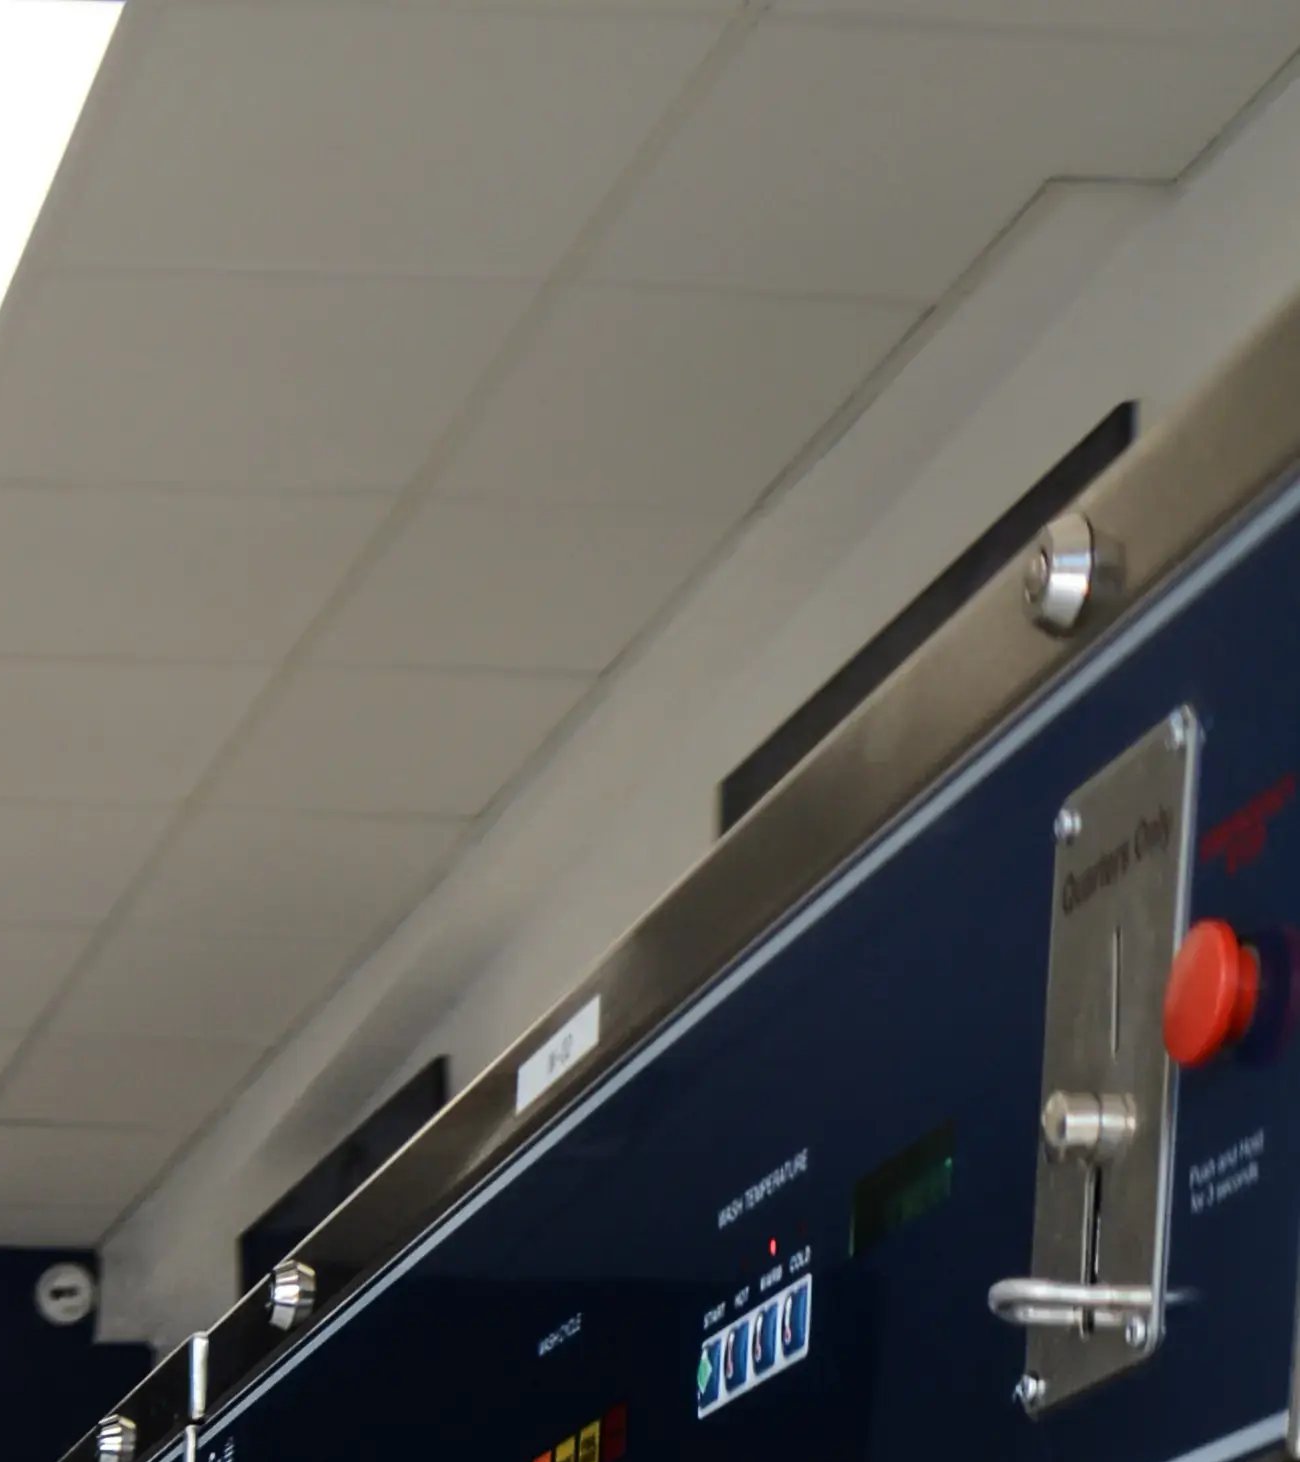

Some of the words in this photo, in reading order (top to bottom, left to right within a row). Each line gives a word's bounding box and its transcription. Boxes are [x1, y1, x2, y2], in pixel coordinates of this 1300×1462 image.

[1134, 804, 1173, 862] Only
[718, 1194, 745, 1230] WASH
[742, 1148, 808, 1210] TEMPERATURE
[703, 1300, 726, 1330] START
[733, 1285, 751, 1310] HOT
[788, 1244, 812, 1275] COLD
